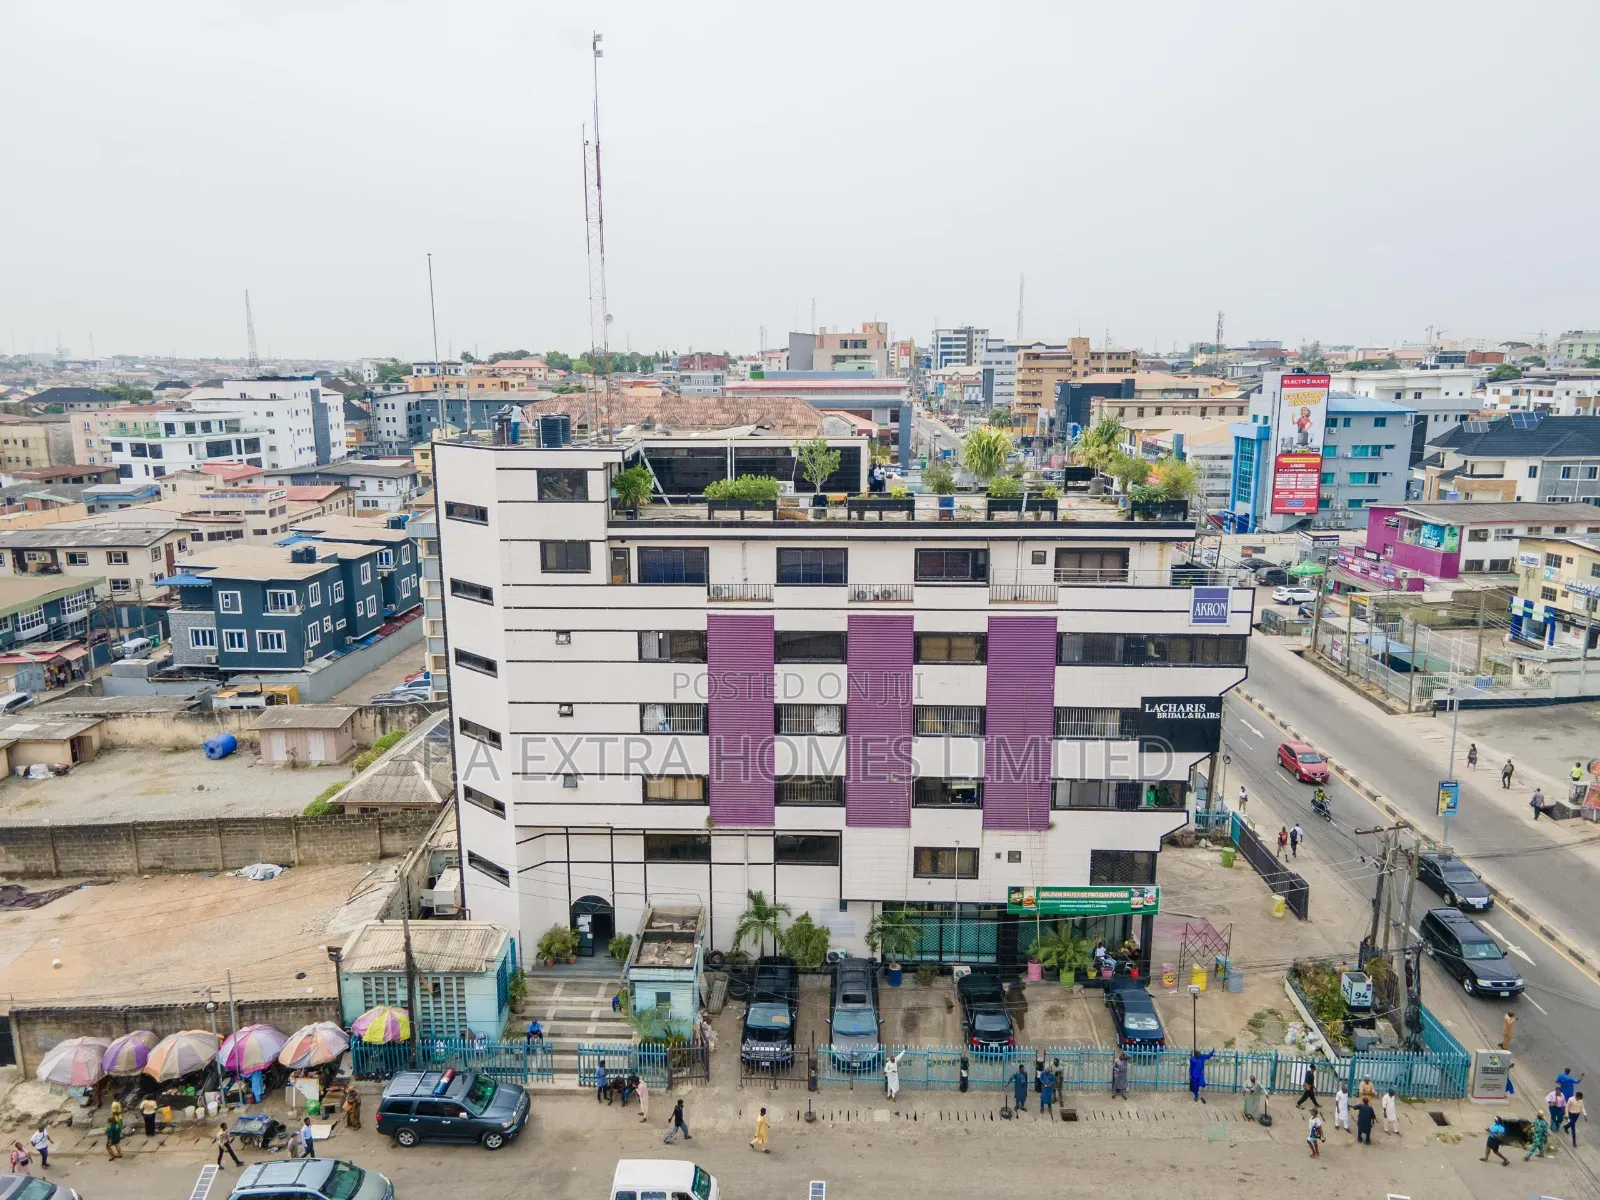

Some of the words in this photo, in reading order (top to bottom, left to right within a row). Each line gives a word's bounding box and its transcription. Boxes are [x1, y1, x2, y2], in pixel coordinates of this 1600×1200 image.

[1194, 602, 1227, 617] AKRON
[1145, 703, 1206, 713] LACHARIS
[1355, 991, 1368, 1000] 94
